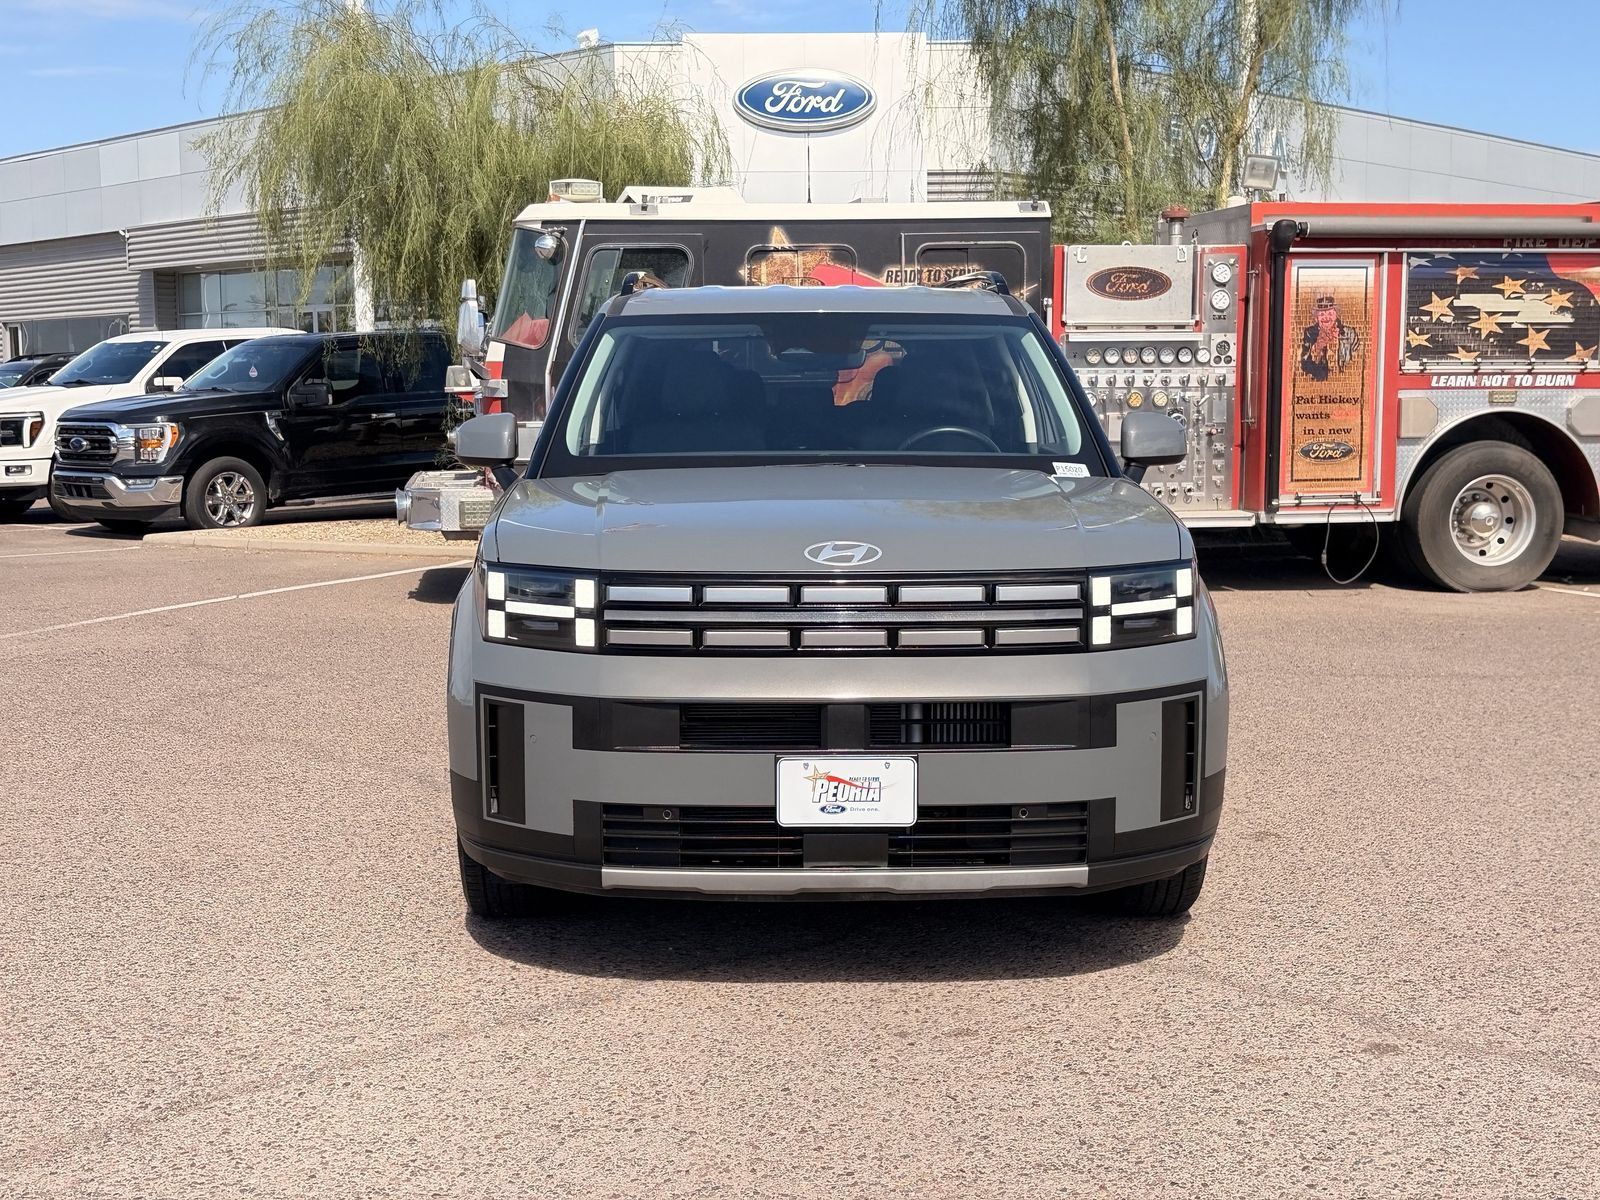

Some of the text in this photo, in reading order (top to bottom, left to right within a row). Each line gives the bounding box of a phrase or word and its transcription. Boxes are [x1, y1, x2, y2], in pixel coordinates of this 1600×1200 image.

[764, 80, 846, 114] Ford
[924, 269, 941, 283] TO
[1106, 272, 1152, 292] Ford
[1431, 374, 1576, 387] LEARN NOT TO BURN
[1295, 394, 1360, 406] Pat Hickey
[1295, 410, 1331, 420] wants
[1303, 426, 1315, 436] in
[1328, 427, 1353, 435] new
[1309, 443, 1345, 458] Ford
[812, 778, 882, 803] PEORIA
